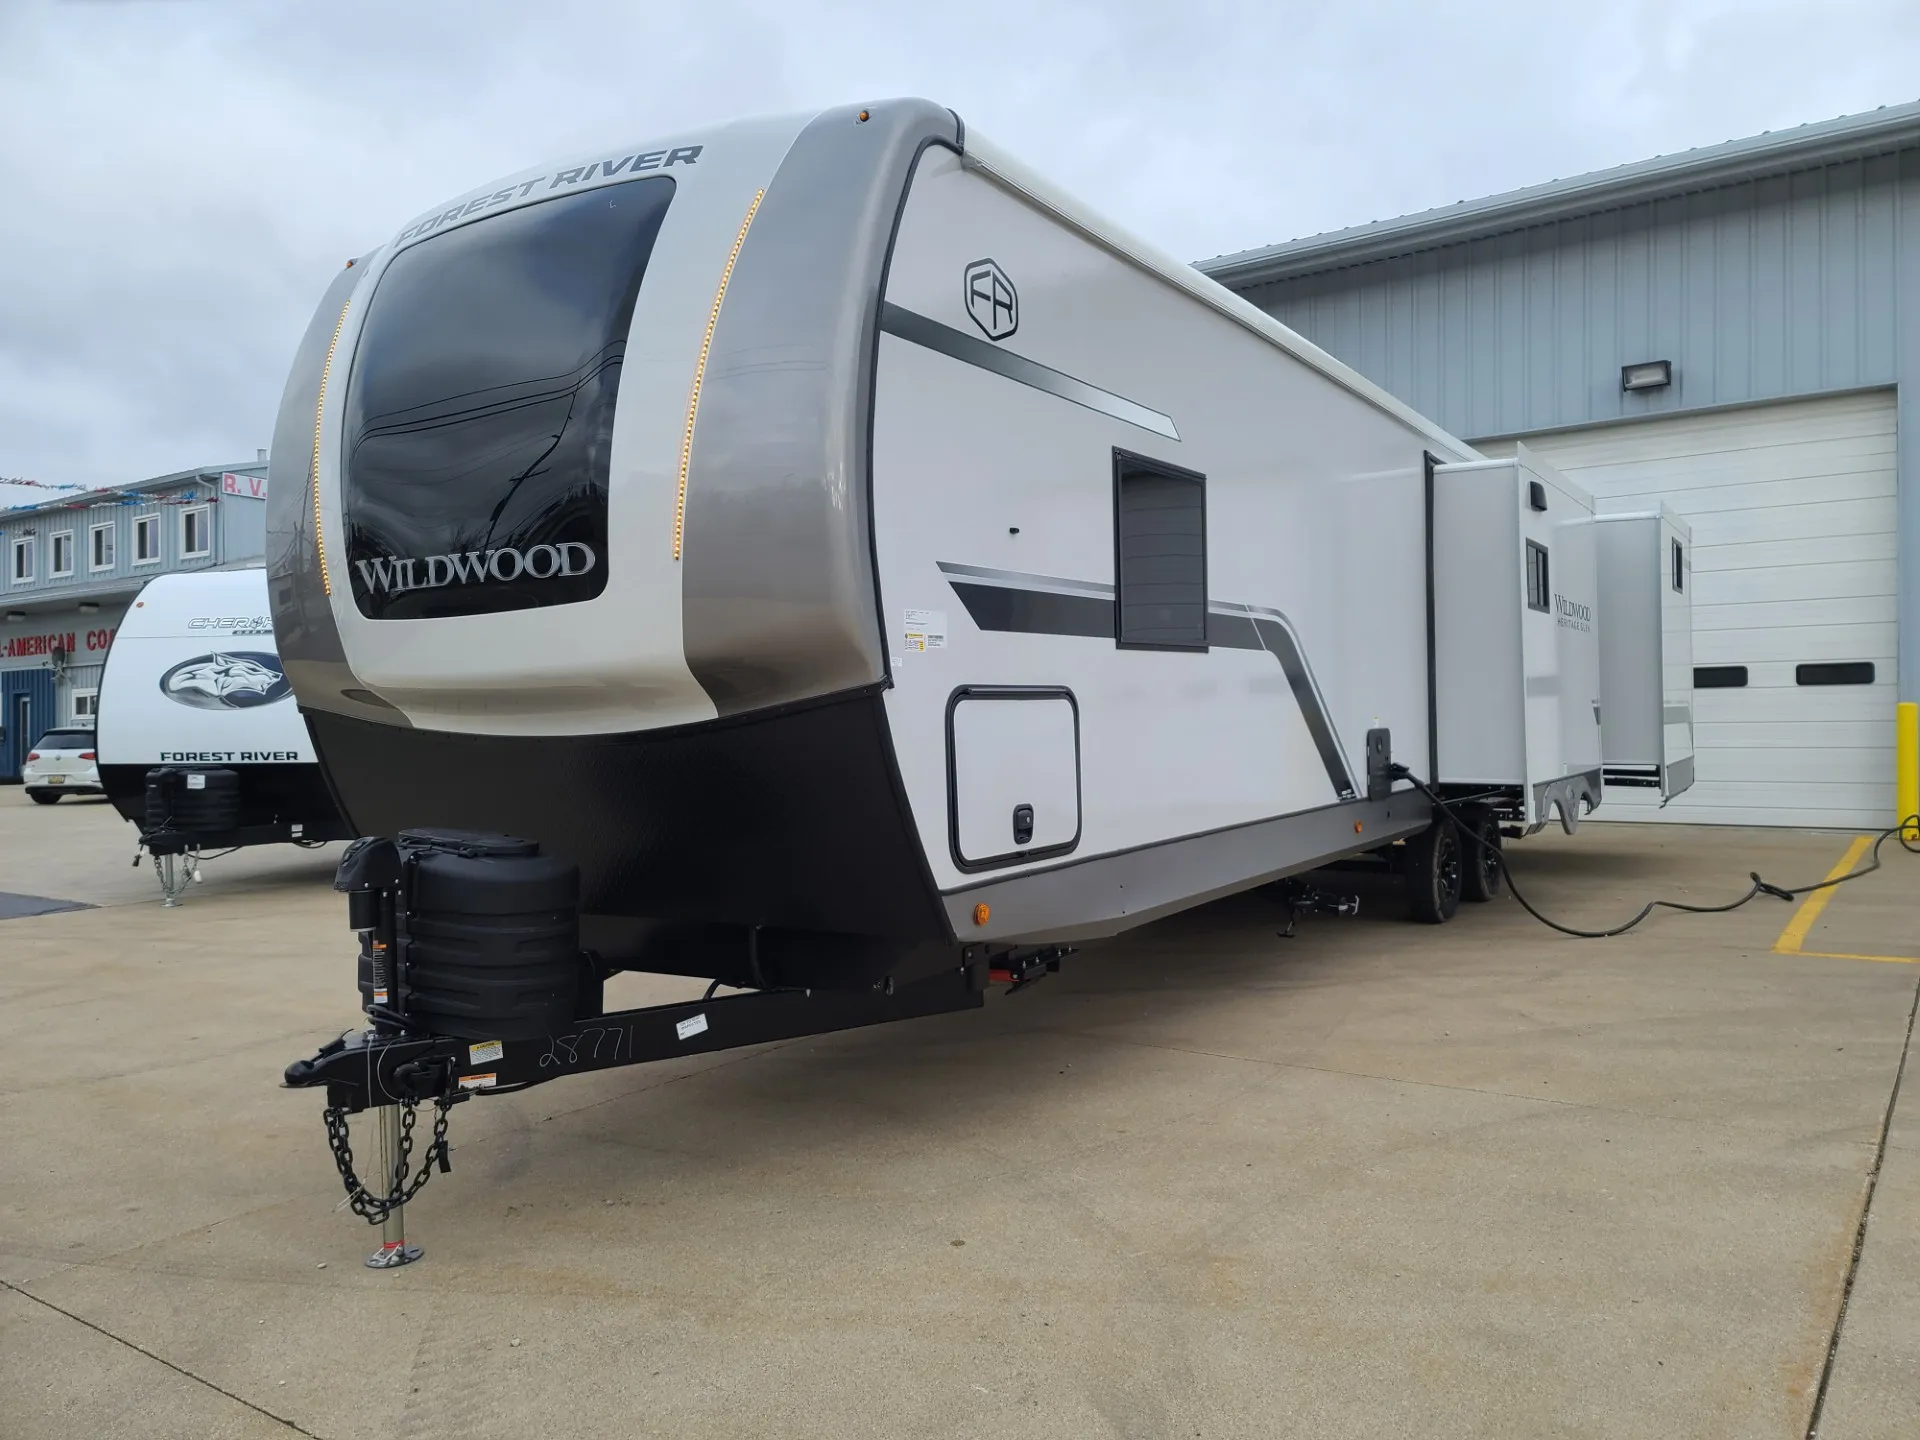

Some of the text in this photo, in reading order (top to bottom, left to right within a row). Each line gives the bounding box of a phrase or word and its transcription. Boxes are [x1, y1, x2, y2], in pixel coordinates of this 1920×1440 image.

[394, 145, 704, 248] FOREST RIVER
[354, 541, 596, 595] WILDWOOD
[1554, 593, 1592, 622] WILDWOOD
[159, 751, 299, 762] FOREST RIVER
